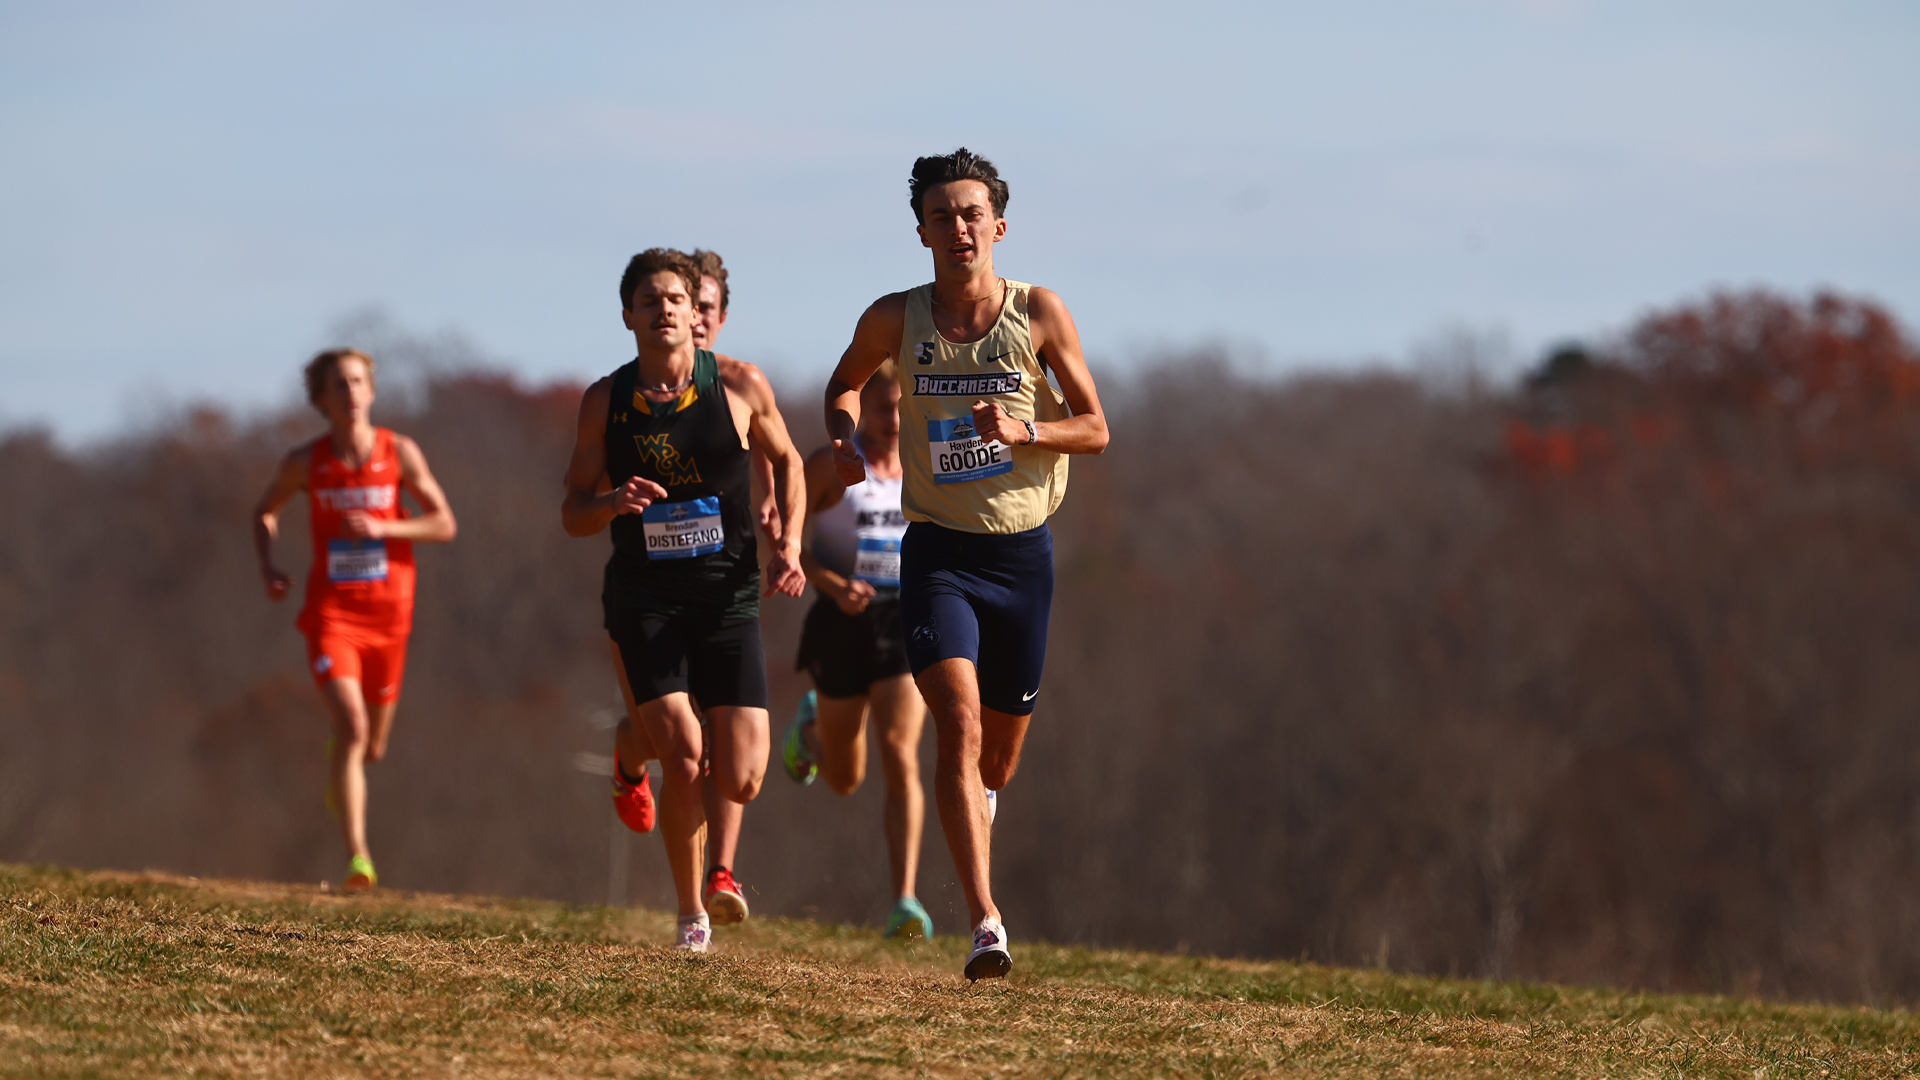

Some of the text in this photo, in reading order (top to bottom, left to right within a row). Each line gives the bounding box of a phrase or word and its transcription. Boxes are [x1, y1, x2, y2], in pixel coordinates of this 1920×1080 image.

[916, 373, 1020, 394] BUCCANEERS
[949, 439, 983, 452] Hayden
[939, 444, 1002, 472] GOODE
[665, 521, 699, 532] Brendan
[648, 527, 719, 548] DISTEFANO
